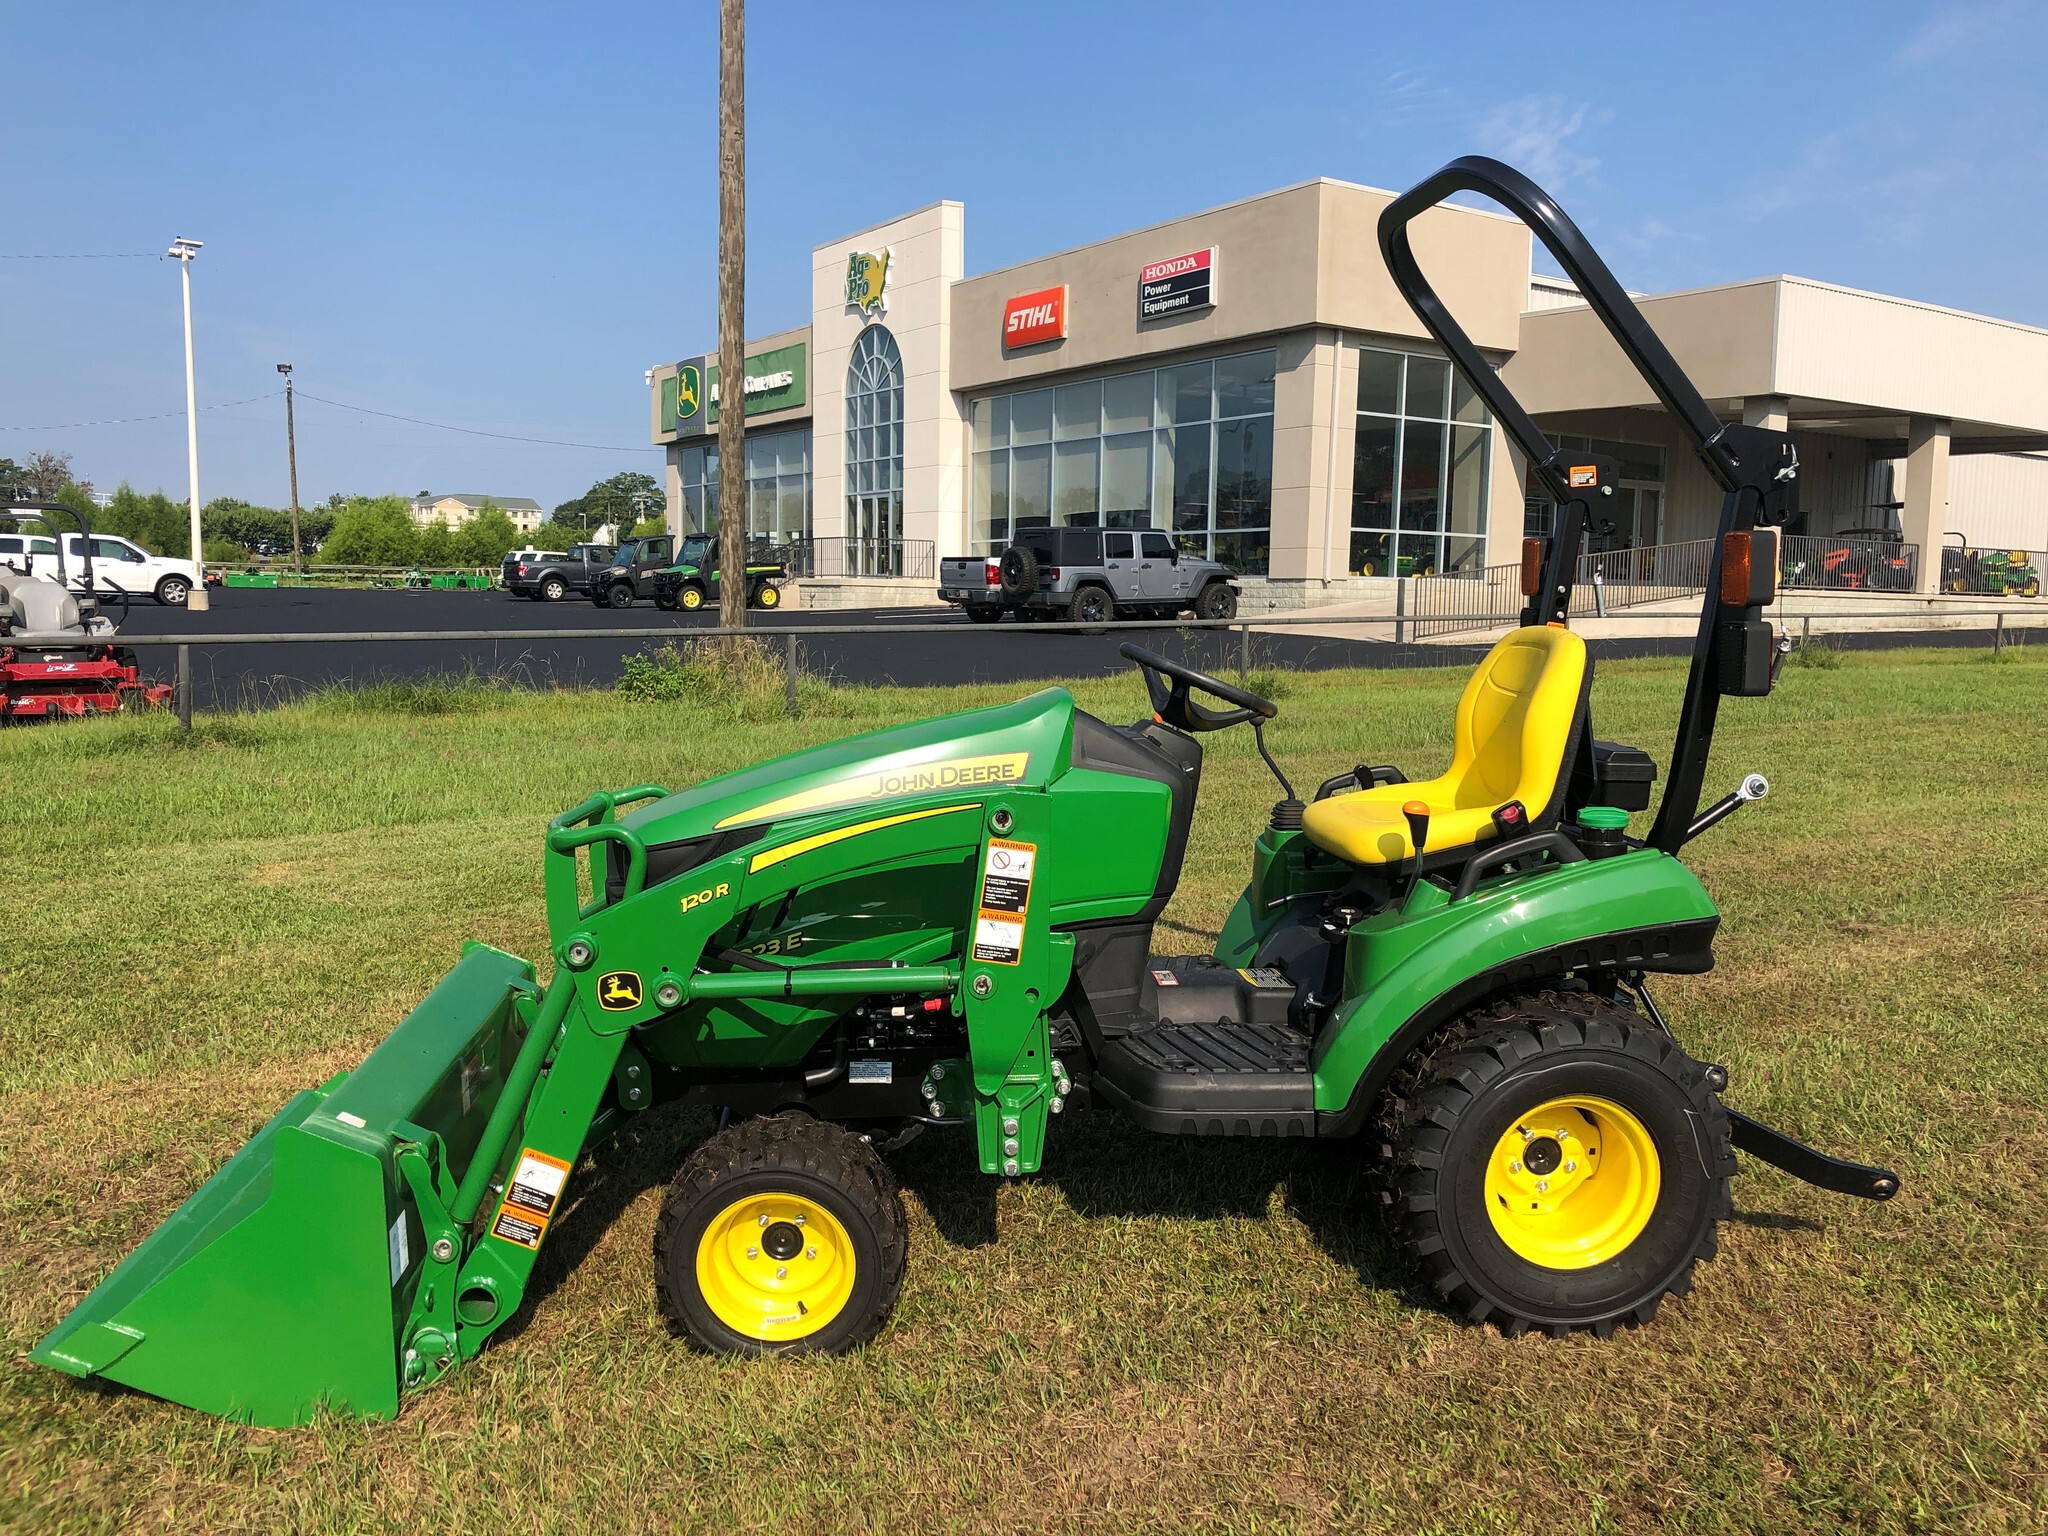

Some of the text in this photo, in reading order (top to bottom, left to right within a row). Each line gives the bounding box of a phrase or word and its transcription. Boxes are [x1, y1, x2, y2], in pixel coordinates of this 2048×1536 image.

[1145, 257, 1198, 279] HONDA
[848, 279, 869, 302] Pro
[1144, 283, 1172, 297] Power
[1144, 294, 1190, 314] Equipment
[1007, 303, 1056, 332] STIHL
[871, 763, 1015, 796] JOHN DEERE
[998, 841, 1034, 852] WARNING
[988, 913, 1023, 923] WARNING
[536, 1154, 565, 1169] WARNING
[513, 1210, 542, 1225] WARNING
